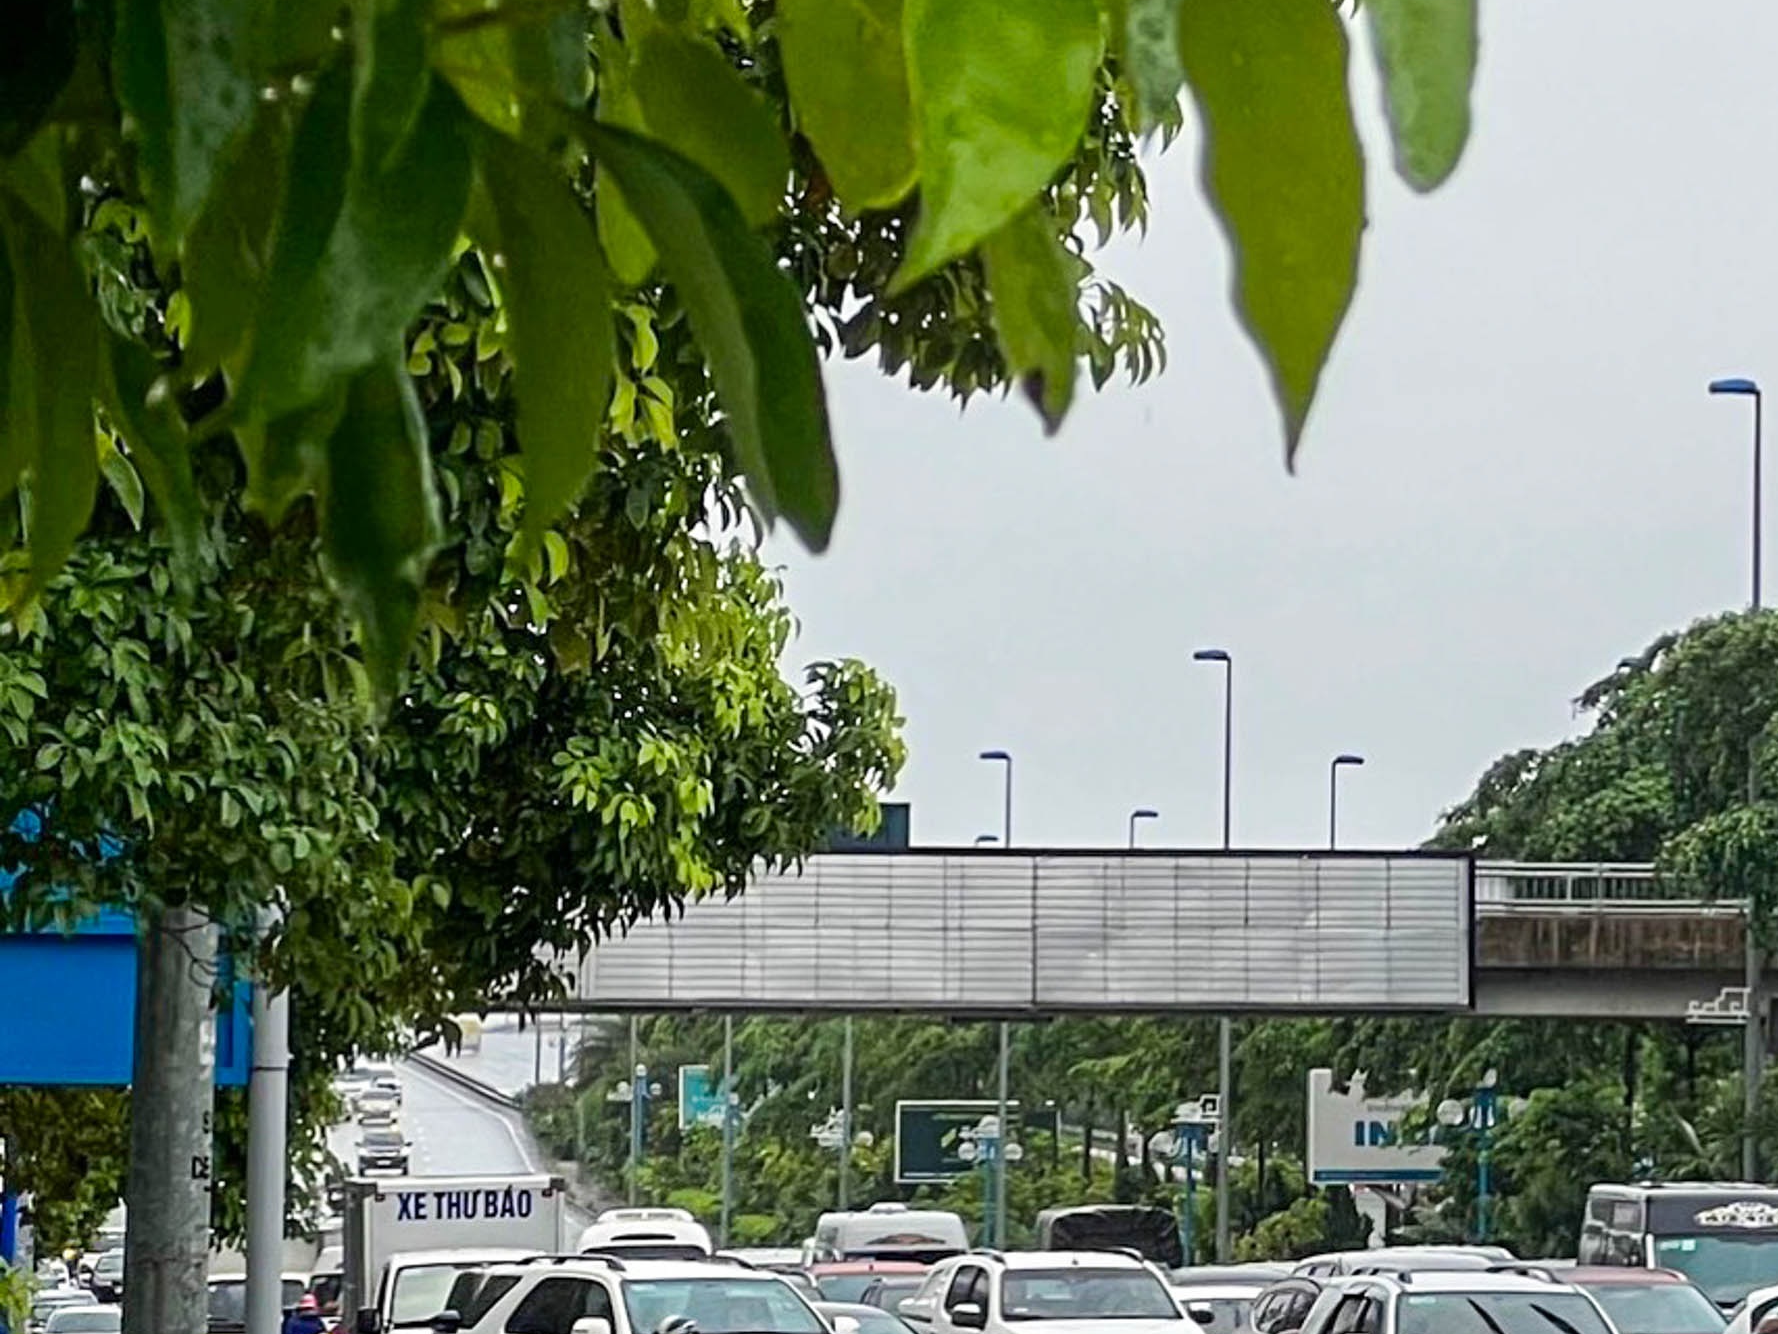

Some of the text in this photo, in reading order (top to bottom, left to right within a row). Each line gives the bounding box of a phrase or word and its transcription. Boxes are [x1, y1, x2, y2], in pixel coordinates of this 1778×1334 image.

[397, 1184, 532, 1221] XE THƯ BÁO
